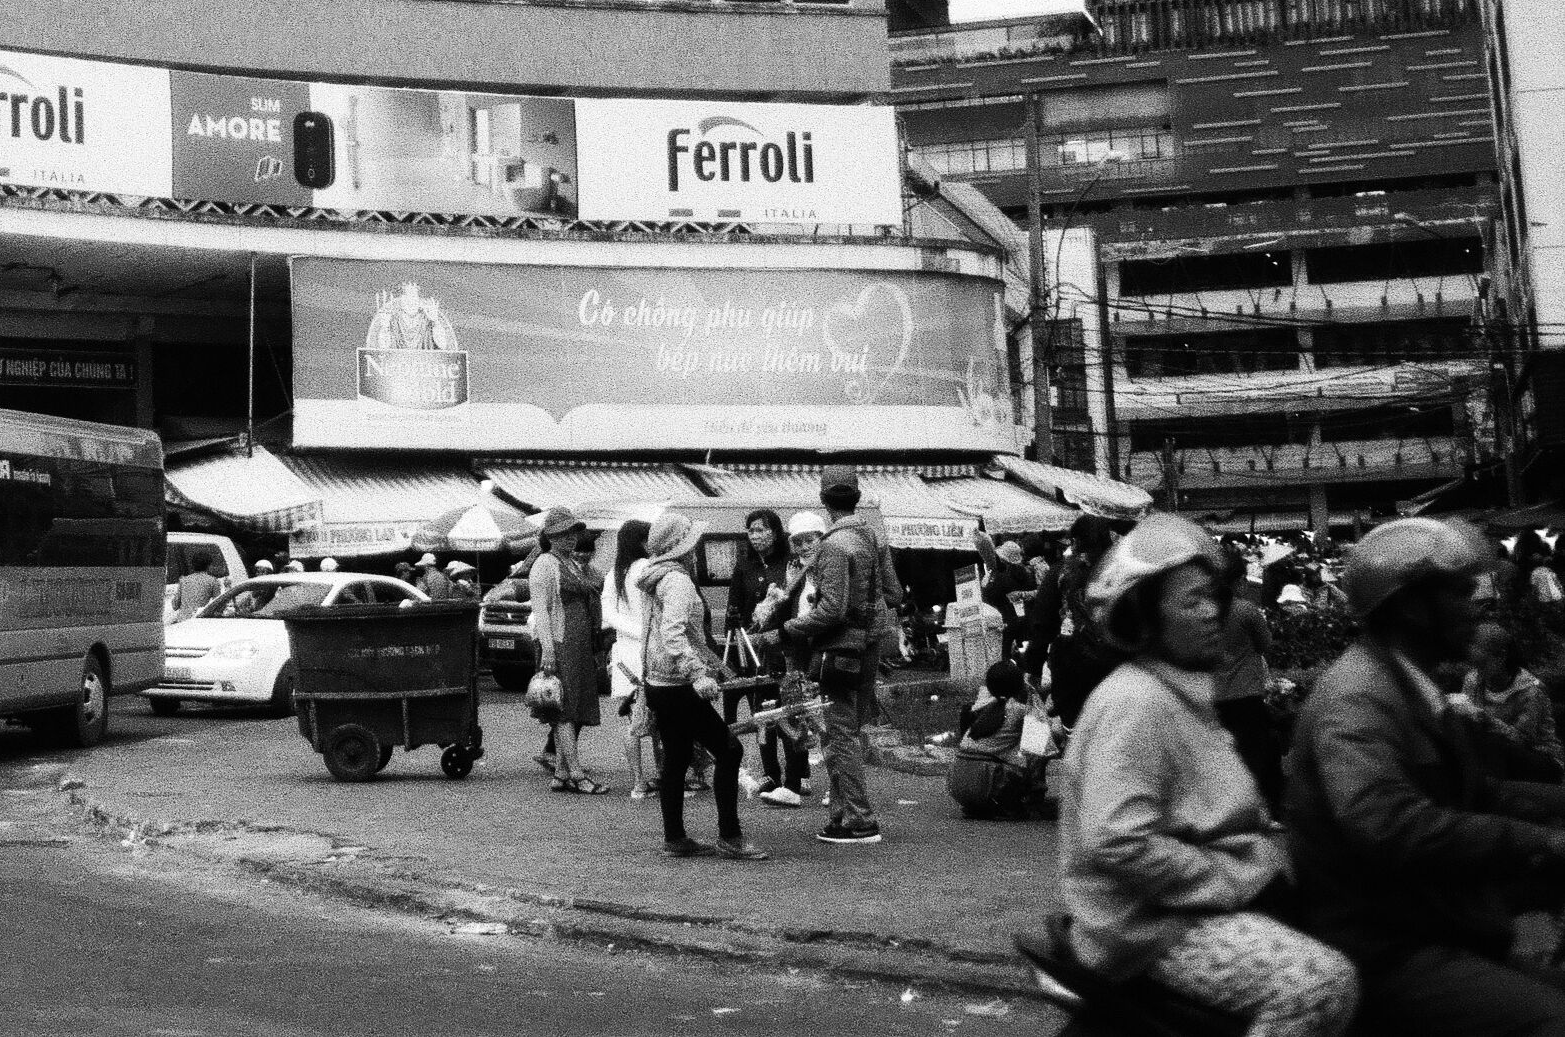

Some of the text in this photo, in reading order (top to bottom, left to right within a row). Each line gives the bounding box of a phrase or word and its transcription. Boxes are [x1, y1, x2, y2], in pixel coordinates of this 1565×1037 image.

[187, 114, 282, 143] AMORE
[33, 169, 86, 184] ITALIA
[764, 208, 817, 219] ITALIA
[578, 289, 615, 325] Có
